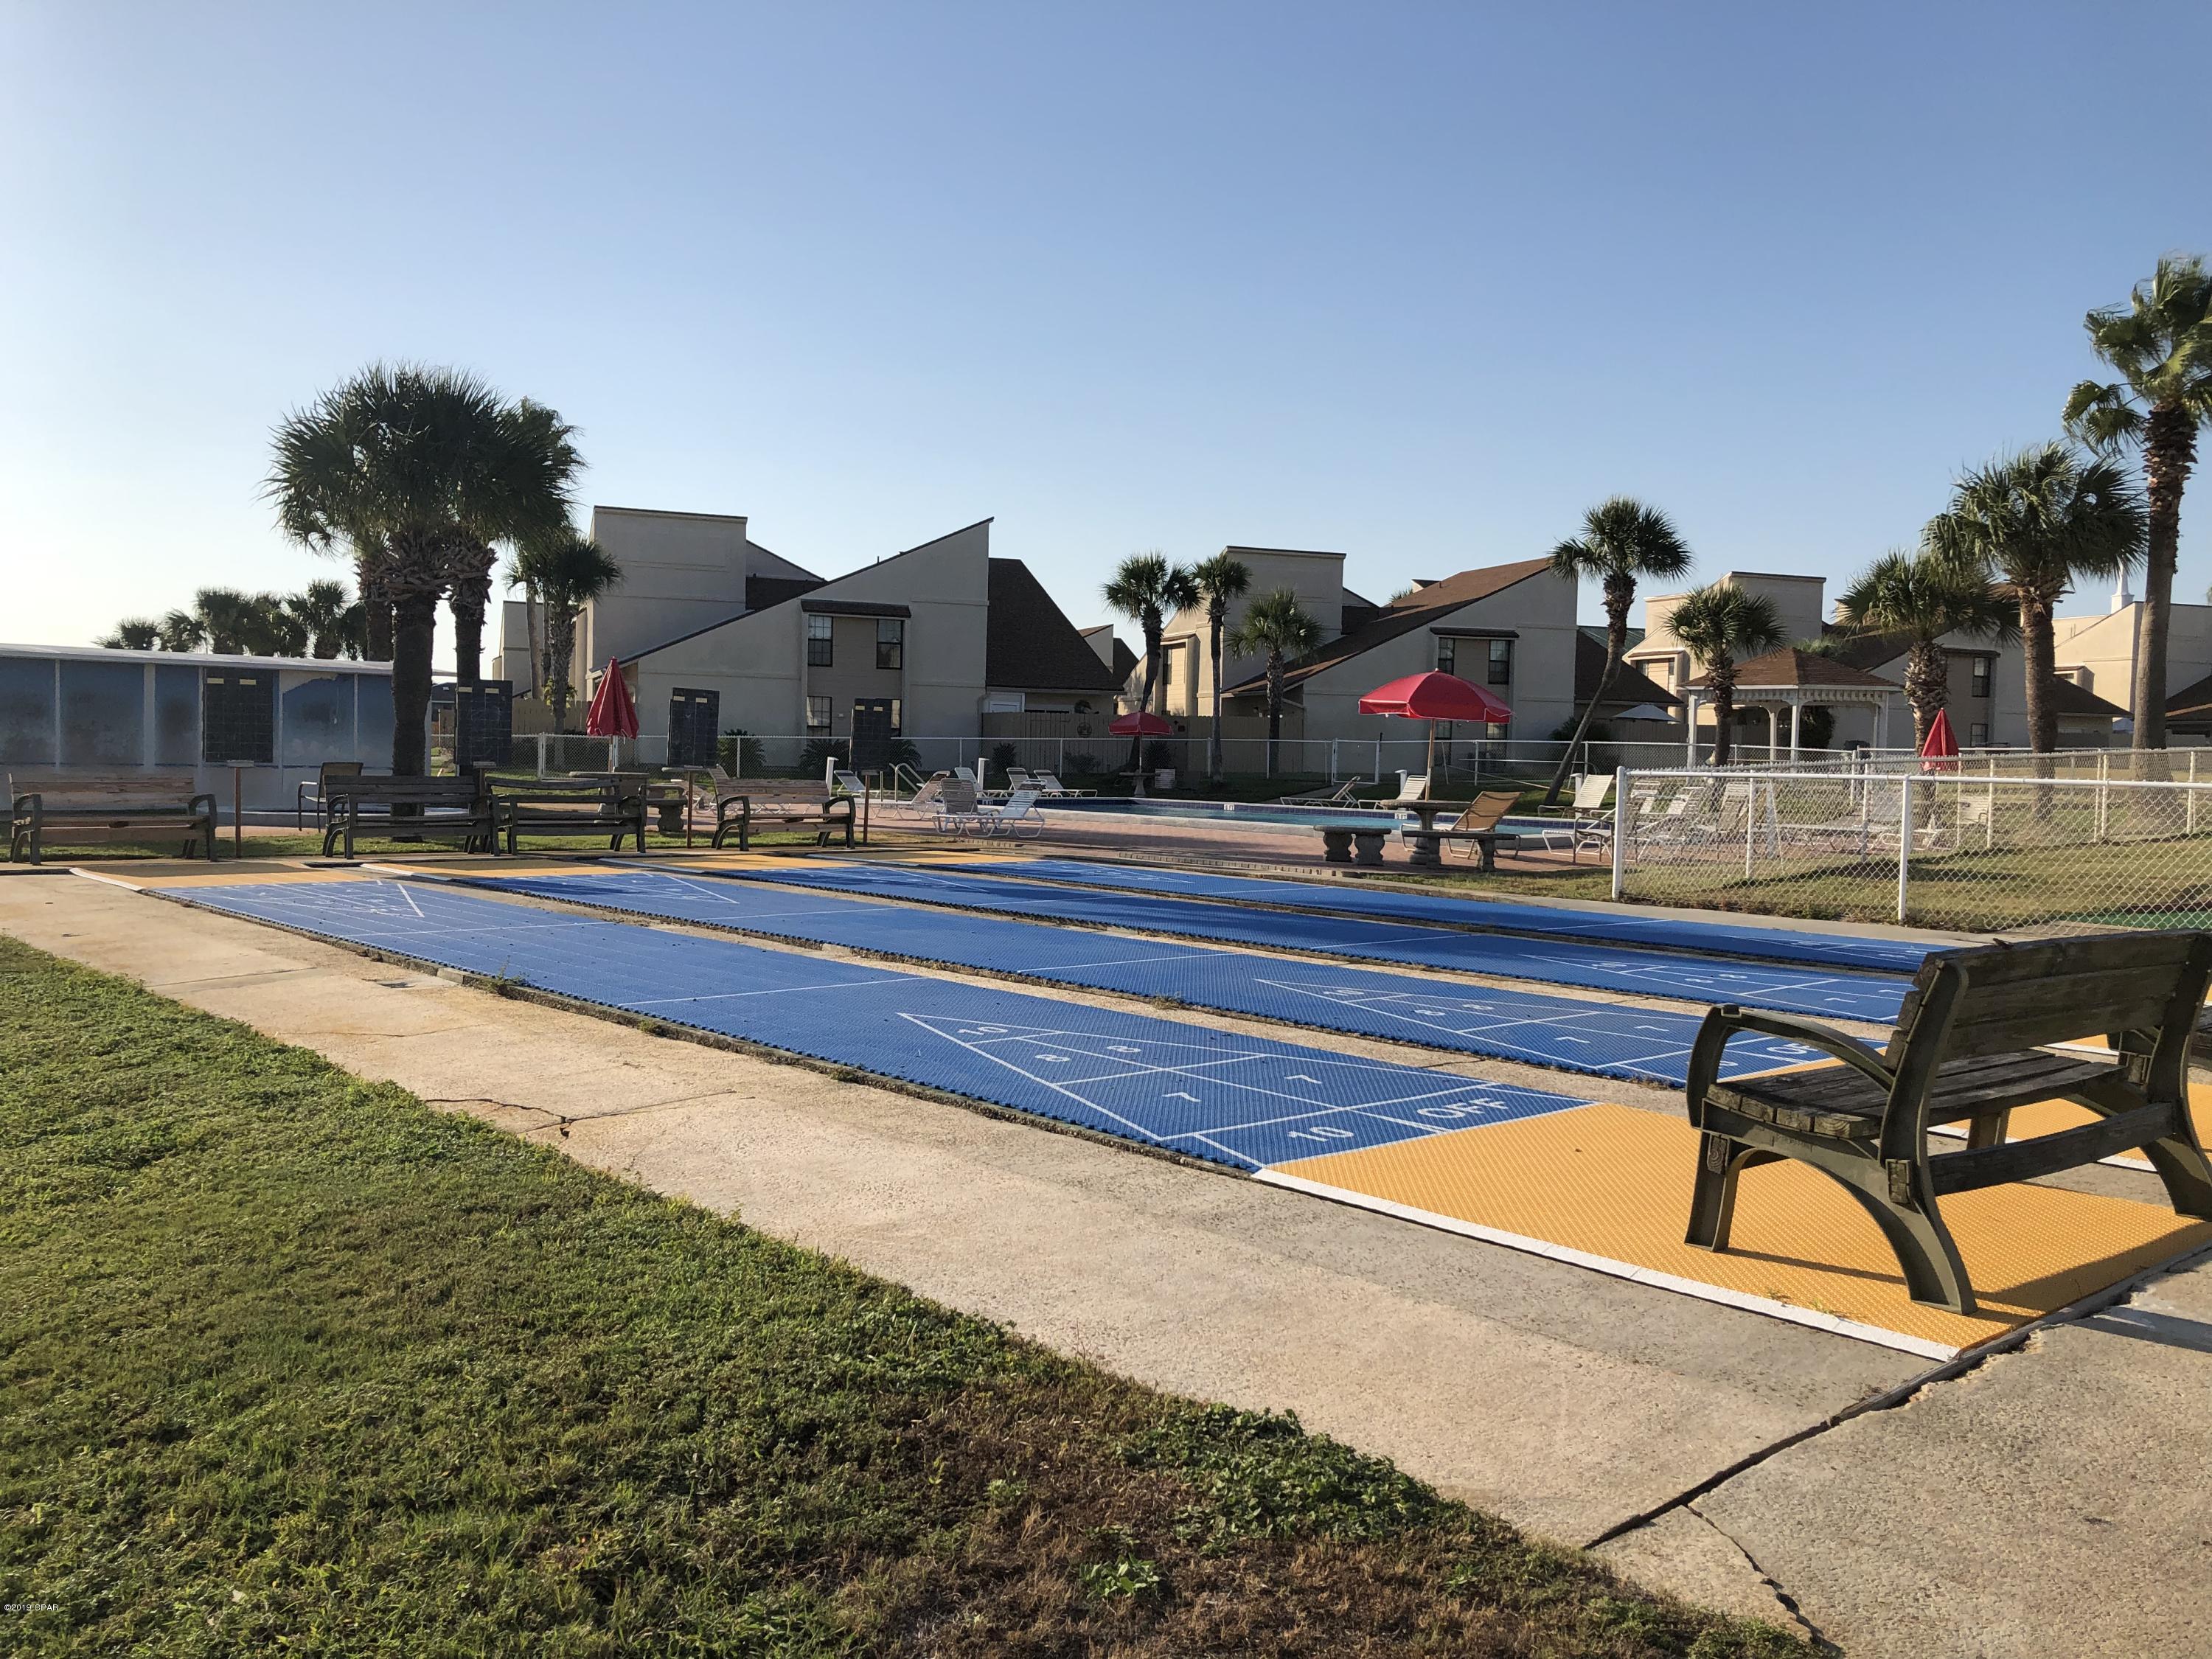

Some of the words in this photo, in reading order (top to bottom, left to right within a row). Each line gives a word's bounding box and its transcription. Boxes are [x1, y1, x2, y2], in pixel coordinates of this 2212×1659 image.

[958, 1026, 1008, 1035] 10
[1107, 1045, 1141, 1053] 8
[1034, 1054, 1070, 1062] 8
[1287, 1126, 1354, 1142] 10
[1416, 1097, 1509, 1119] OFF
